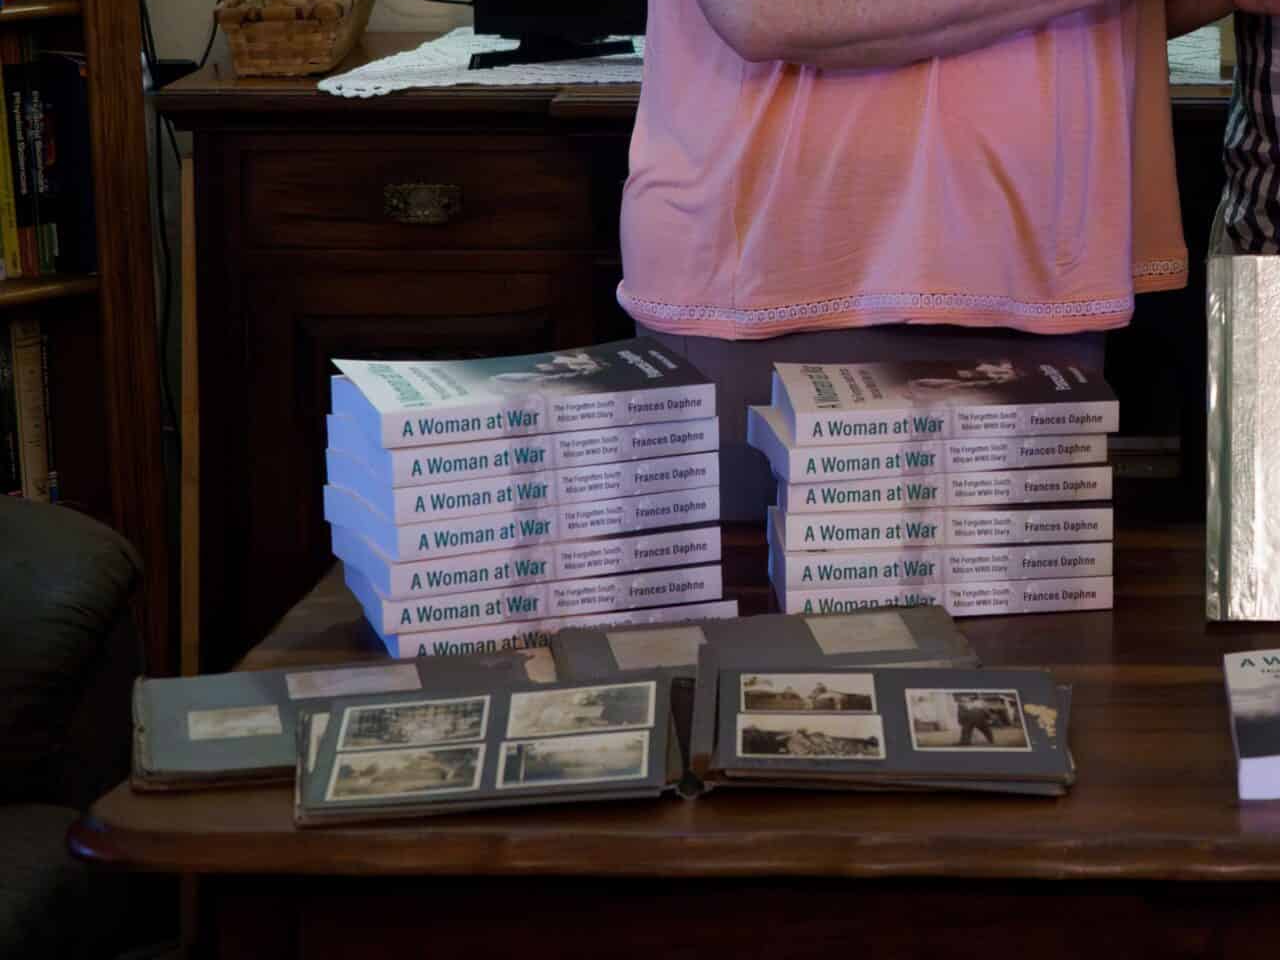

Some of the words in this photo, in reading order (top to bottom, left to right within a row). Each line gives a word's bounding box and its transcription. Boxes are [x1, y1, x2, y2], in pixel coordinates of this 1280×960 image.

[628, 402, 664, 412] Frances
[667, 398, 702, 412] Daphne
[402, 420, 414, 437] A
[418, 416, 481, 436] Woman
[486, 413, 503, 430] at
[506, 409, 539, 427] War
[813, 421, 823, 437] A
[828, 420, 888, 437] Woman
[893, 419, 908, 434] at
[913, 416, 944, 433] War
[1030, 415, 1066, 425] Frances
[1068, 414, 1103, 426] Daphne
[632, 436, 668, 448] Frances
[670, 431, 704, 445] Daphne
[1020, 447, 1056, 457] Frances
[1057, 444, 1092, 456] Daphne
[411, 459, 422, 477] A
[427, 454, 488, 474] Woman
[494, 450, 509, 466] at
[514, 447, 546, 464] War
[806, 458, 817, 475] A
[822, 456, 880, 473] Woman
[885, 453, 901, 469] at
[905, 451, 936, 468] War
[634, 471, 669, 483] Frances
[672, 467, 706, 480] Daphne
[806, 488, 817, 504] A
[821, 487, 880, 504] Woman
[886, 485, 902, 501] at
[906, 484, 938, 500] War
[1024, 481, 1060, 492] Frances
[1063, 480, 1097, 493] Daphne
[415, 495, 426, 513] A
[430, 490, 491, 511] Woman
[497, 485, 513, 502] at
[516, 482, 549, 500] War
[635, 506, 671, 519] Frances
[673, 501, 706, 514] Daphne
[418, 533, 430, 551] A
[434, 528, 494, 548] Woman
[500, 523, 516, 540] at
[520, 518, 551, 537] War
[805, 525, 815, 542] A
[820, 525, 880, 541] Woman
[885, 523, 901, 539] at
[906, 522, 938, 538] War
[1024, 521, 1061, 532] Frances
[1063, 521, 1098, 533] Daphne
[634, 547, 670, 559] Frances
[672, 542, 708, 556] Daphne
[802, 566, 813, 581] A
[818, 565, 877, 580] Woman
[883, 562, 899, 578] at
[903, 560, 935, 576] War
[1022, 558, 1058, 568] Frances
[1060, 556, 1096, 568] Daphne
[411, 572, 422, 590] A
[426, 569, 489, 588] Woman
[494, 565, 510, 580] at
[515, 560, 546, 577] War
[629, 585, 666, 597] Frances
[669, 581, 704, 594] Daphne
[1023, 591, 1060, 601] Frances
[1062, 590, 1096, 603] Daphne
[401, 608, 412, 625] A
[416, 604, 480, 623] Woman
[485, 600, 502, 615] at
[506, 596, 539, 613] War
[804, 599, 813, 614] A
[818, 598, 879, 614] Woman
[885, 595, 899, 608] at
[904, 593, 936, 607] War
[418, 643, 428, 657] A
[433, 640, 496, 656] Woman
[502, 634, 517, 649] at
[1240, 658, 1256, 668] A
